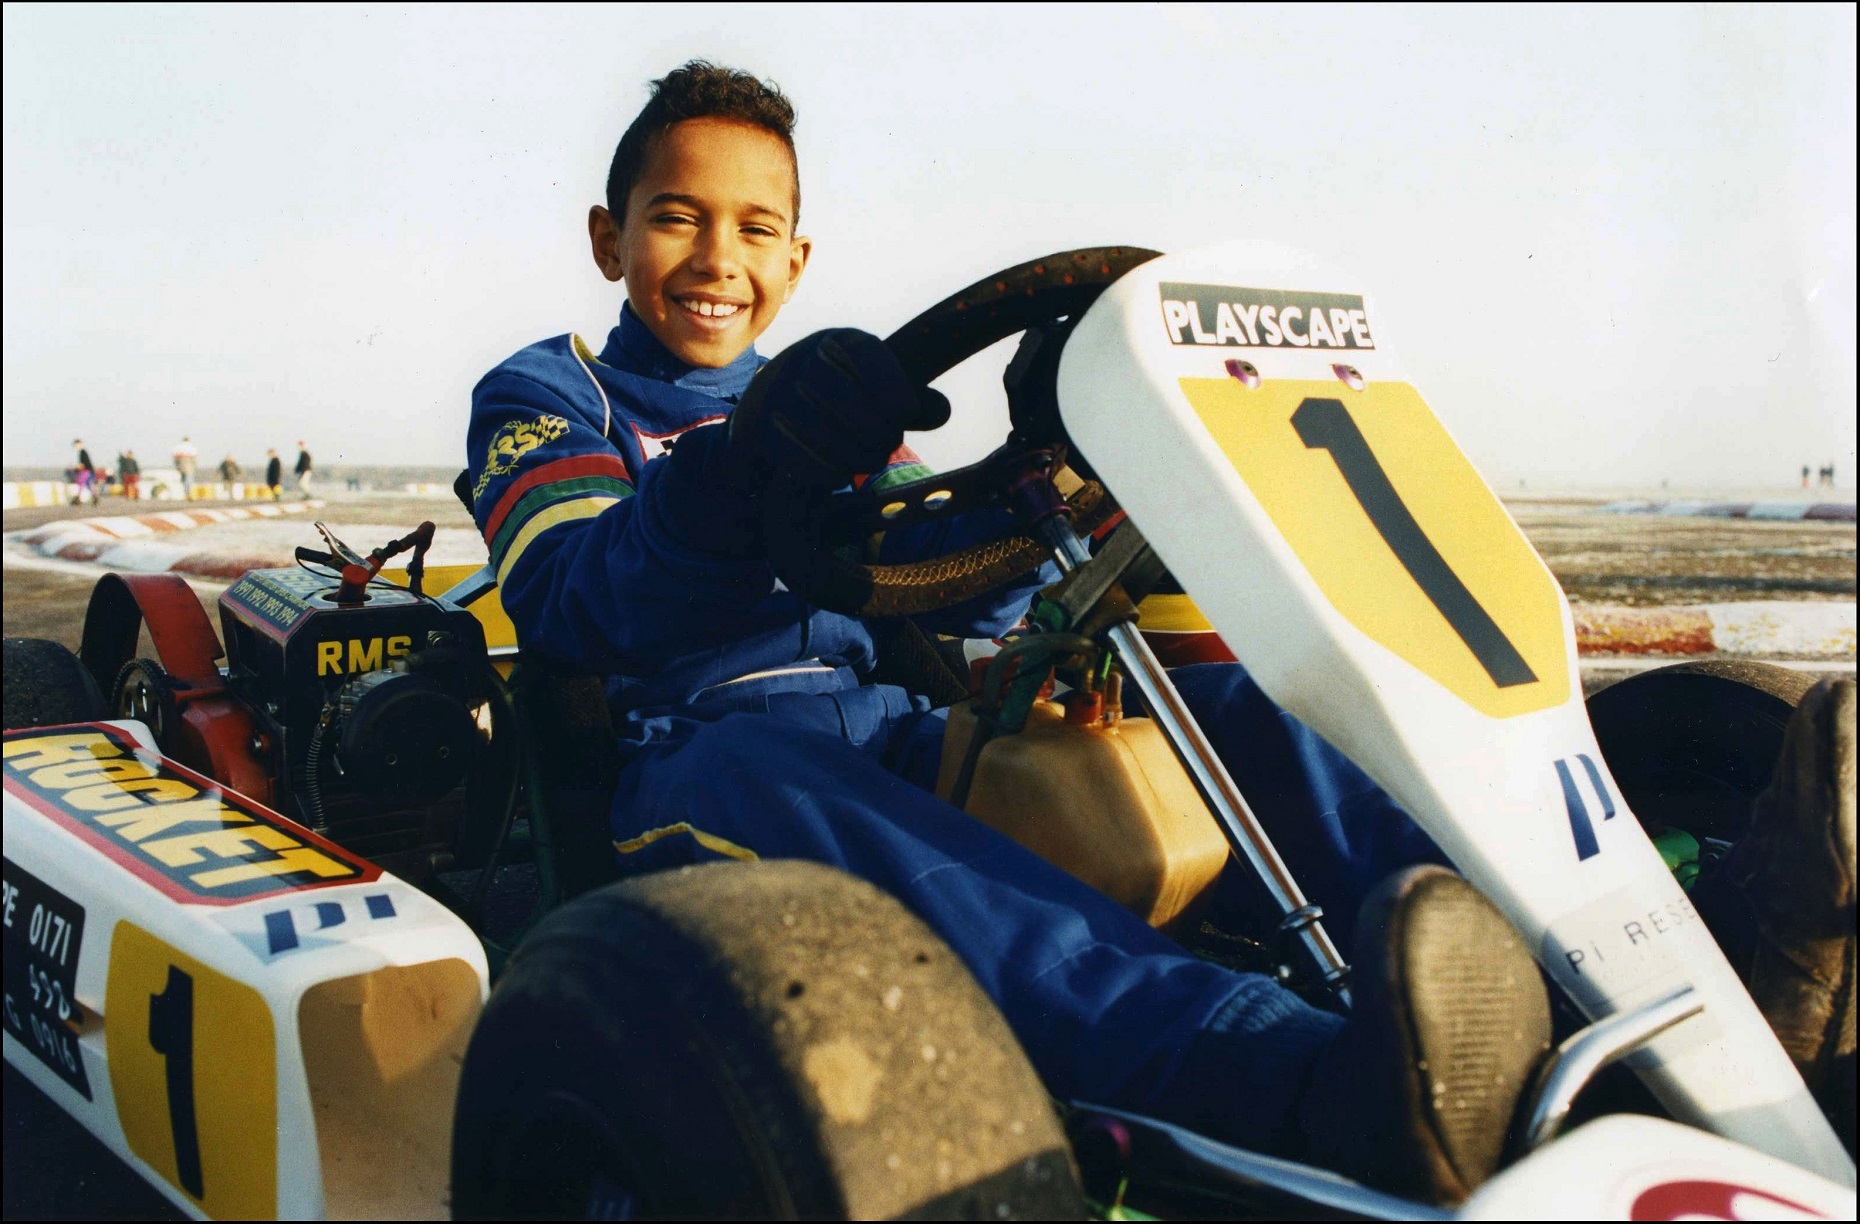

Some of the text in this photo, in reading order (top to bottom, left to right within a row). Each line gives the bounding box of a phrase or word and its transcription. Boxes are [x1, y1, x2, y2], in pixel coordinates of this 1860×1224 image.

[1161, 299, 1375, 348] PLAYSCAPE
[1289, 397, 1540, 688] 1
[233, 580, 255, 599] 1991
[246, 588, 270, 608] 1992
[261, 597, 285, 618] 1993
[275, 606, 301, 627] 1994
[317, 635, 412, 677] RMS
[3, 734, 355, 889] ROCKET
[28, 903, 72, 966] 0171
[148, 964, 204, 1200] 1
